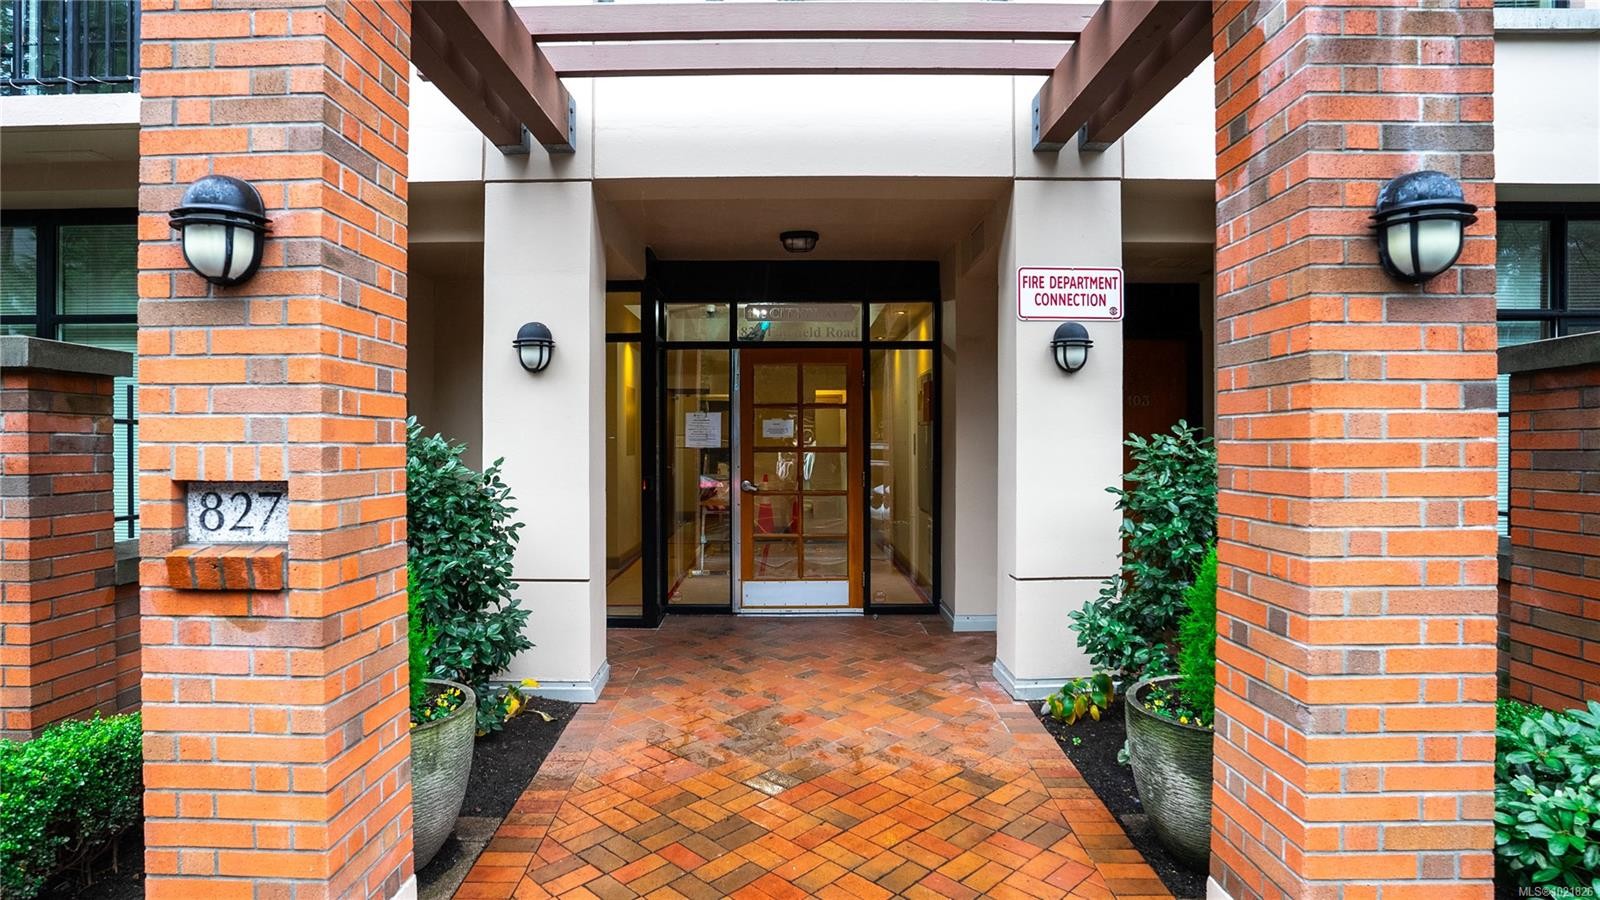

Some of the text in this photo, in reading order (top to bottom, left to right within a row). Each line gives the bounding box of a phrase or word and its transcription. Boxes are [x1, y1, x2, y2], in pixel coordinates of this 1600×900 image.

[1022, 275, 1119, 290] FIRE DEPARTMENT
[1034, 292, 1107, 307] CONNECTION
[826, 326, 859, 338] Road
[199, 491, 283, 532] 827
